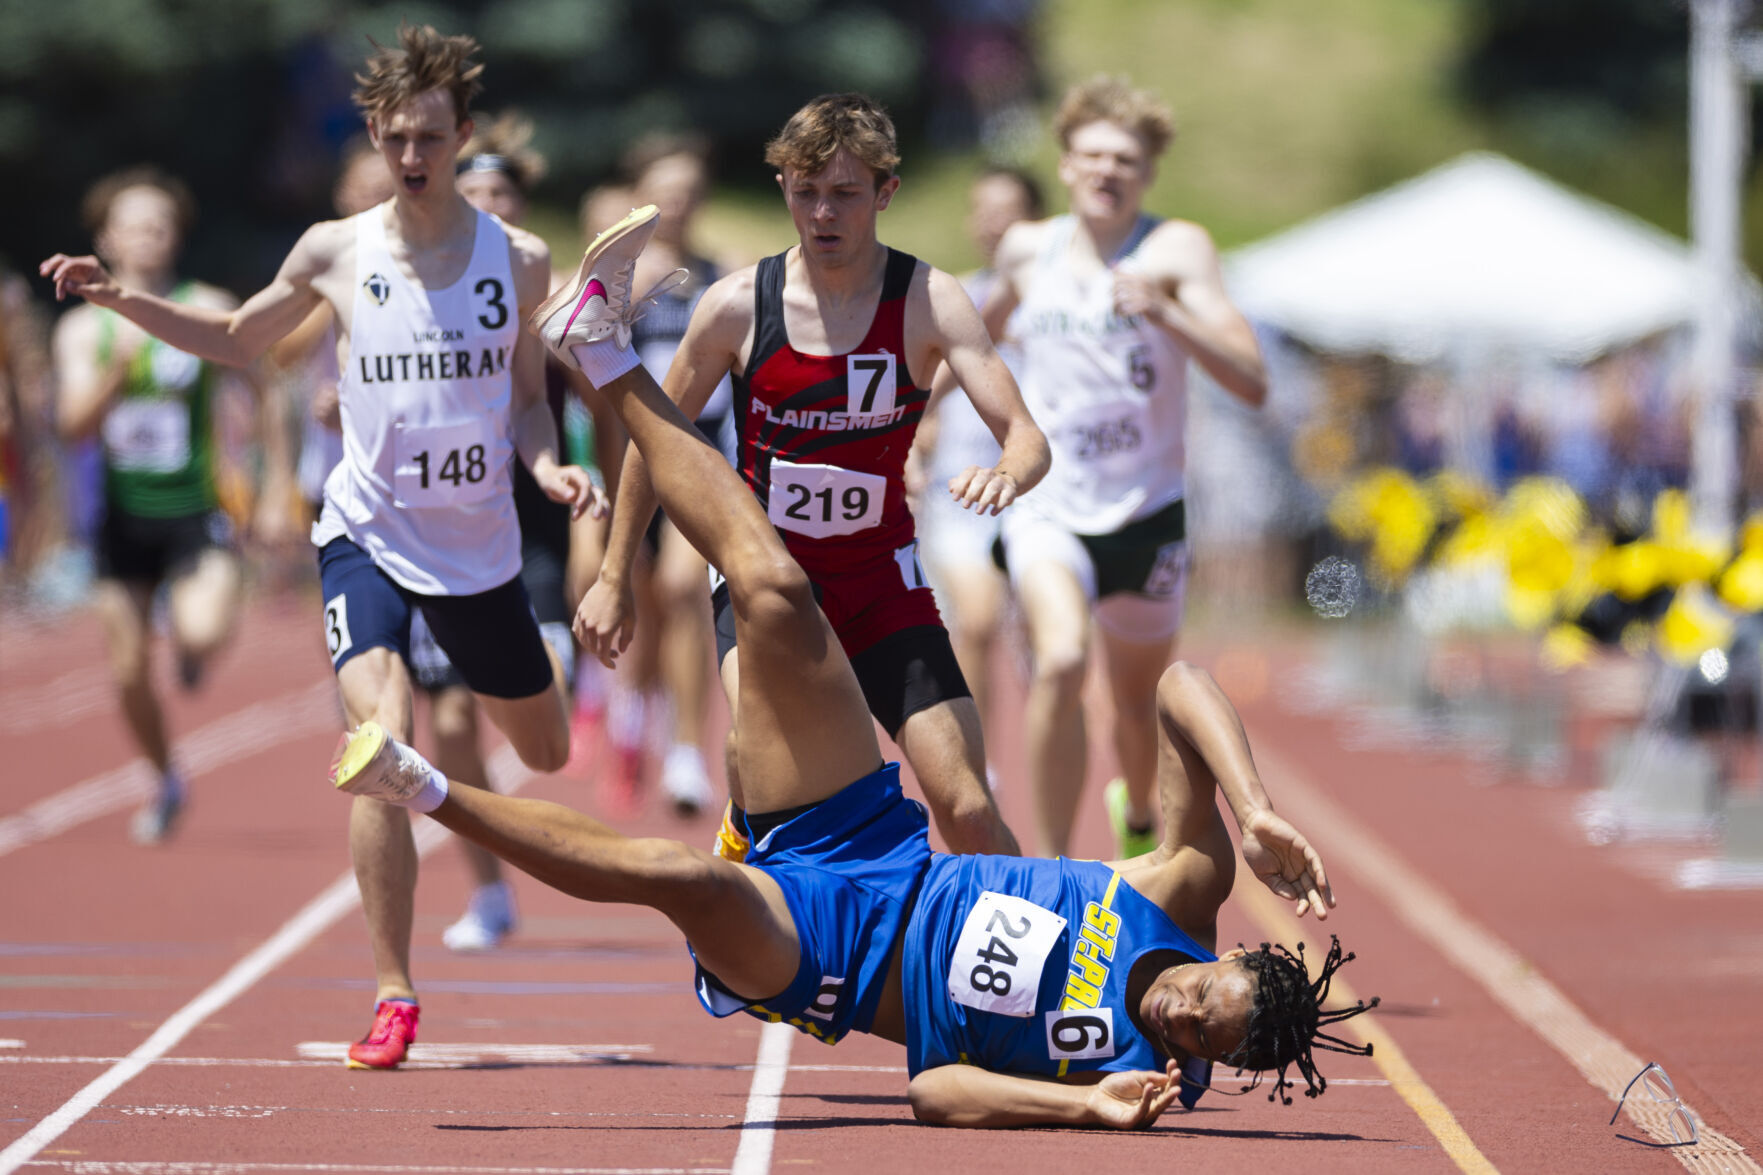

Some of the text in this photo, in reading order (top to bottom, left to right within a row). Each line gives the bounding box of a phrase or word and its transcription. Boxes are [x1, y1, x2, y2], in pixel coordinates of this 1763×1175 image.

[474, 278, 508, 331] 3
[413, 329, 464, 344] LINCOLN
[853, 359, 888, 413] 7
[751, 396, 907, 432] PLAINSMEN
[412, 443, 486, 489] 148
[785, 483, 869, 522] 219
[326, 607, 342, 657] 3
[970, 909, 1032, 997] 248
[1051, 1015, 1109, 1053] 6
